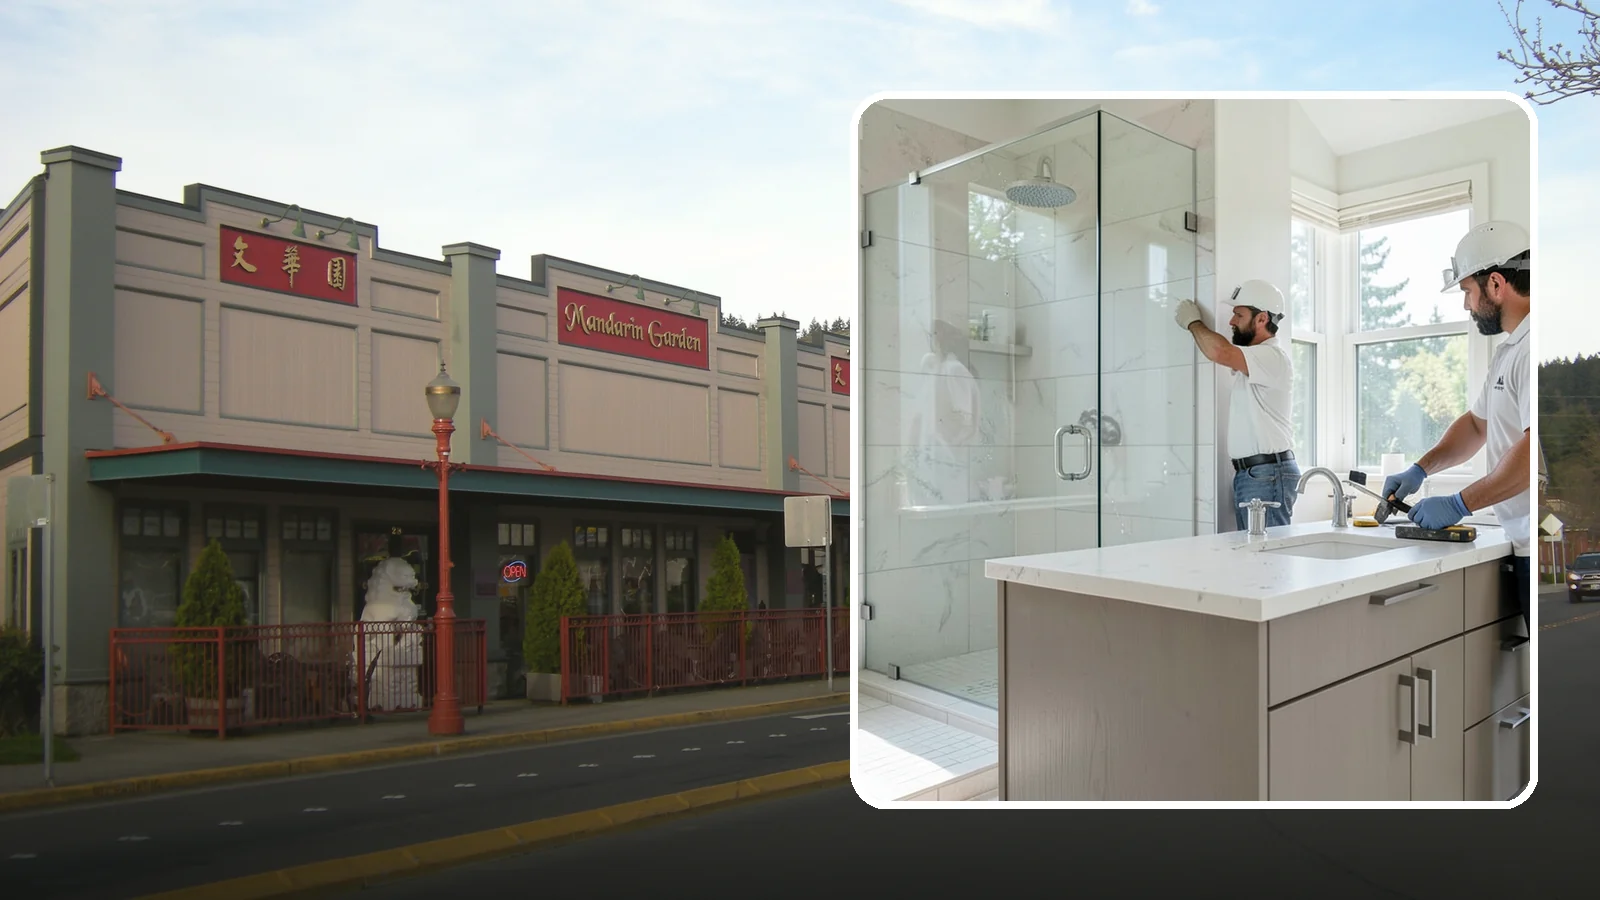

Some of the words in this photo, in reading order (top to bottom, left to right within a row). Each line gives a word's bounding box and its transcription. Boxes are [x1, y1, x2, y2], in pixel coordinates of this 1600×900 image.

[231, 236, 346, 291] 文華園
[564, 302, 644, 341] Mandarin
[648, 320, 701, 352] Garden
[835, 363, 847, 386] 文
[503, 565, 527, 578] OPEN
